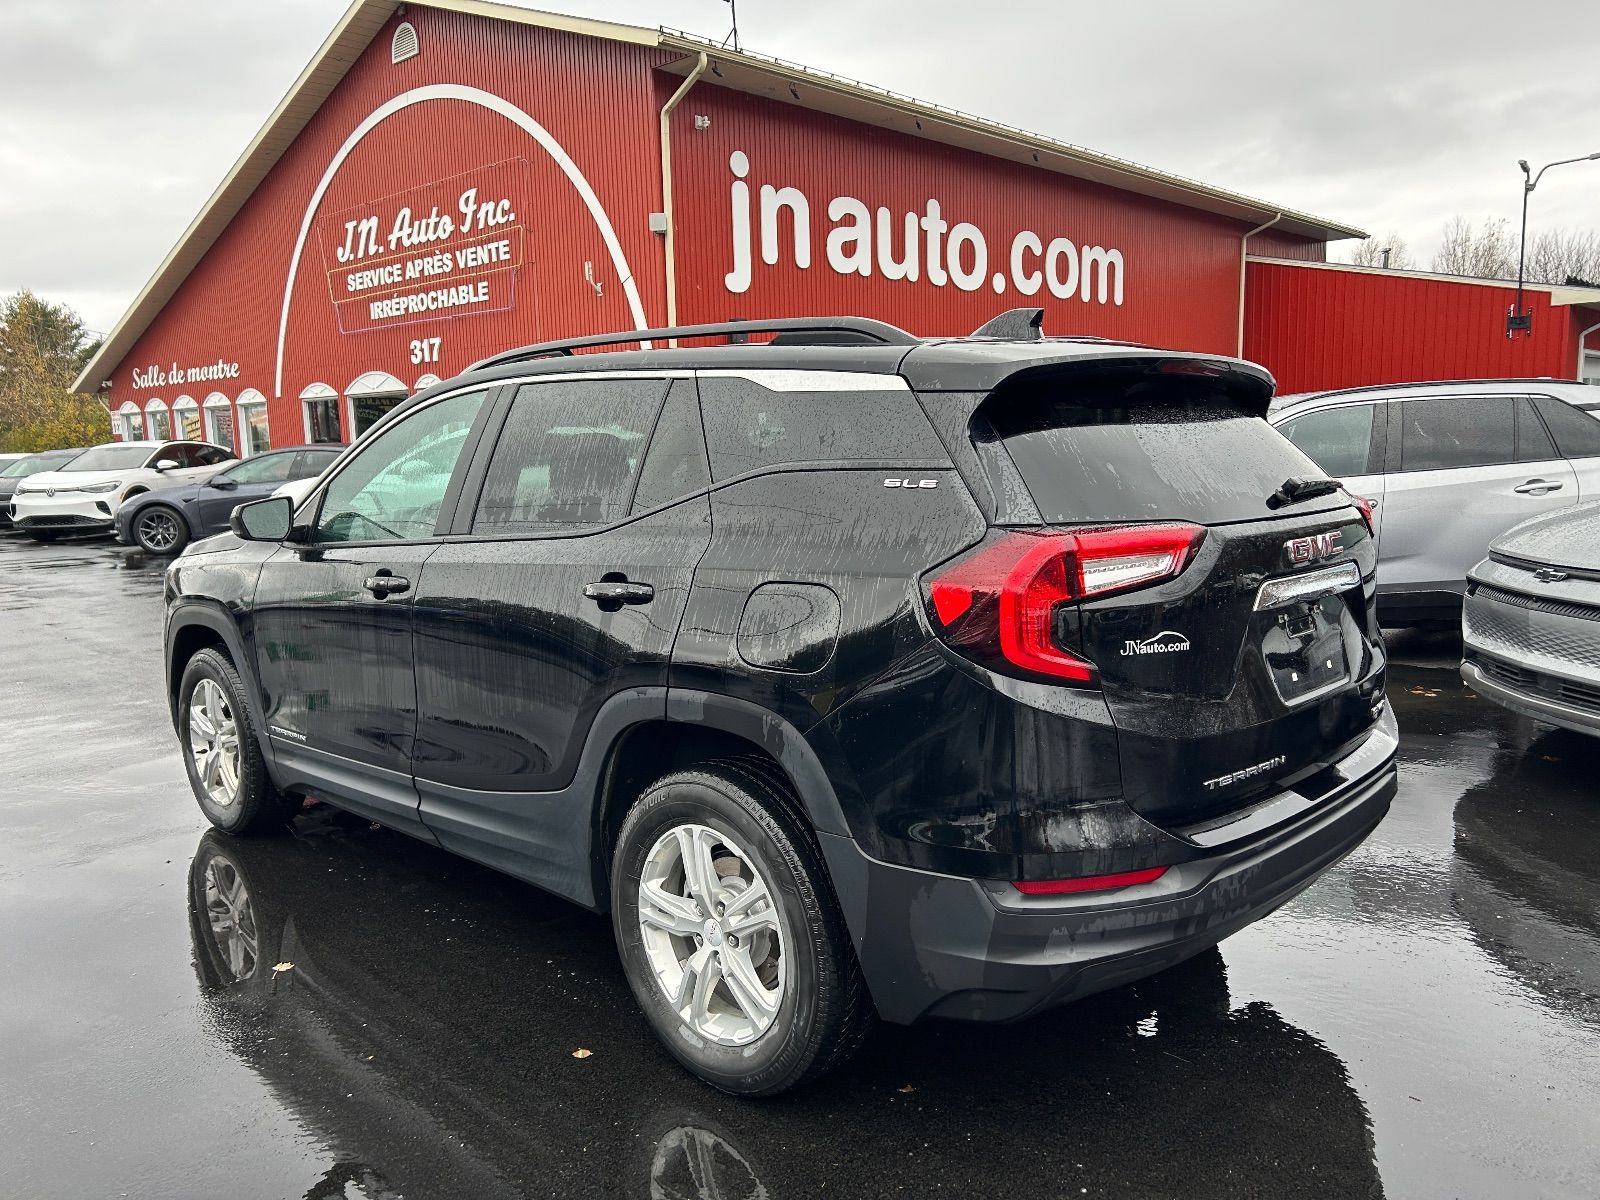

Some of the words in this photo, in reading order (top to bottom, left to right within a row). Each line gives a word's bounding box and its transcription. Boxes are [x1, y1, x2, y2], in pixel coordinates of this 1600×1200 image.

[388, 207, 455, 250] Auto
[458, 187, 516, 233] Inc.
[347, 263, 402, 292] SERVICE
[405, 251, 453, 280] APRÈS
[455, 239, 511, 269] VENTE
[369, 281, 490, 320] IRRÉPROCHABLE
[409, 337, 442, 365] 317
[132, 364, 167, 390] Salle
[168, 362, 185, 385] de
[187, 358, 240, 383] montre
[883, 478, 939, 489] SLE
[1287, 530, 1344, 563] GMC
[1120, 639, 1190, 656] JNauto.com
[1202, 754, 1286, 790] TERRAIN
